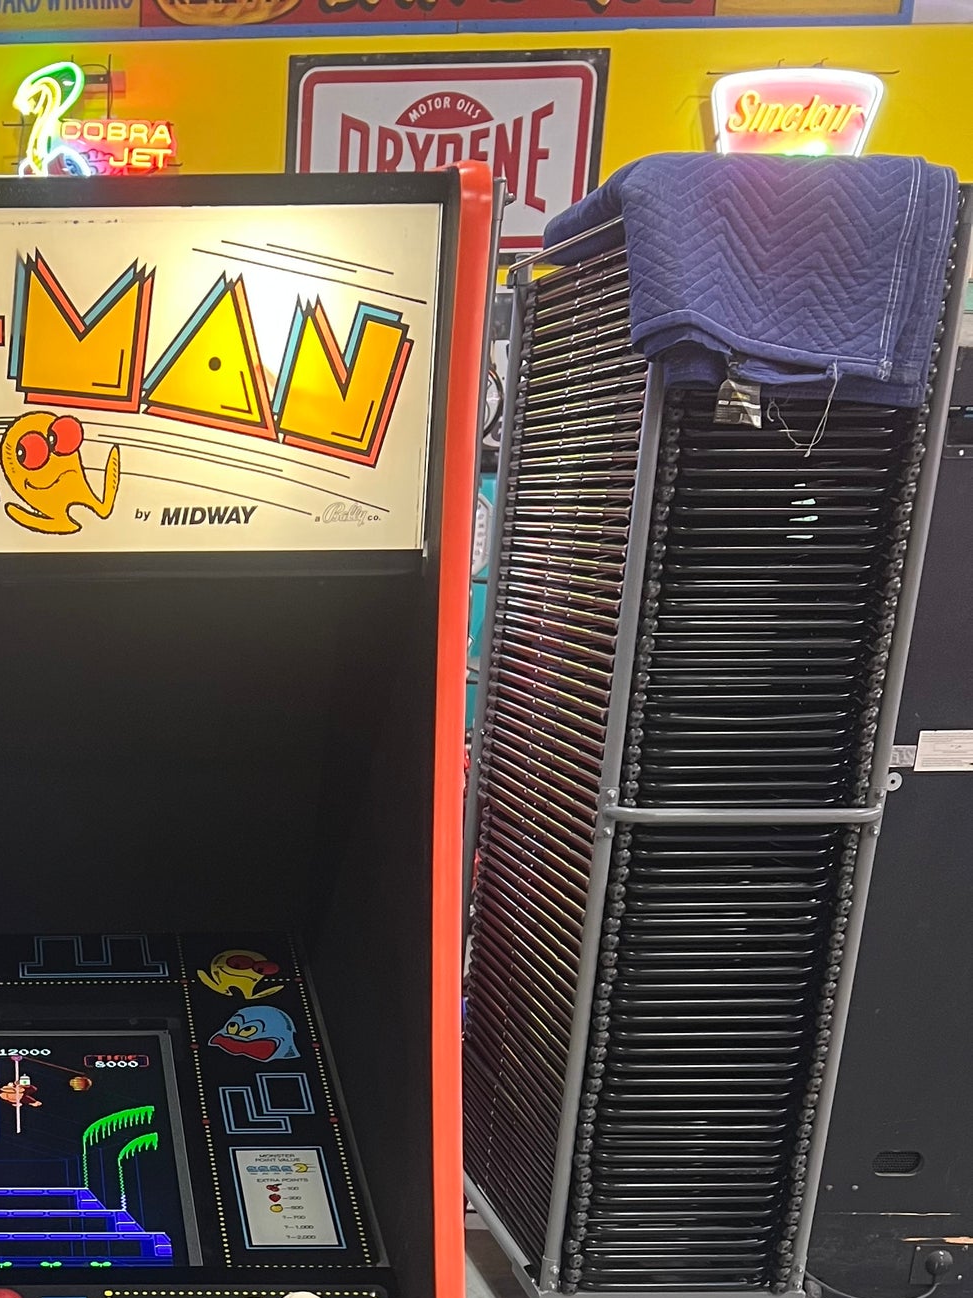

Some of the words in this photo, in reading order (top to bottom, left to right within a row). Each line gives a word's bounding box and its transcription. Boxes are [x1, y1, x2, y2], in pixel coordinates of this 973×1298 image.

[408, 96, 451, 123] MOTOR
[456, 98, 482, 120] OILS
[728, 90, 865, 134] Sinclair
[60, 120, 172, 145] COBRA
[108, 147, 173, 169] JET
[134, 508, 151, 521] by
[160, 505, 258, 526] MIDWAY
[322, 501, 368, 527] Bally
